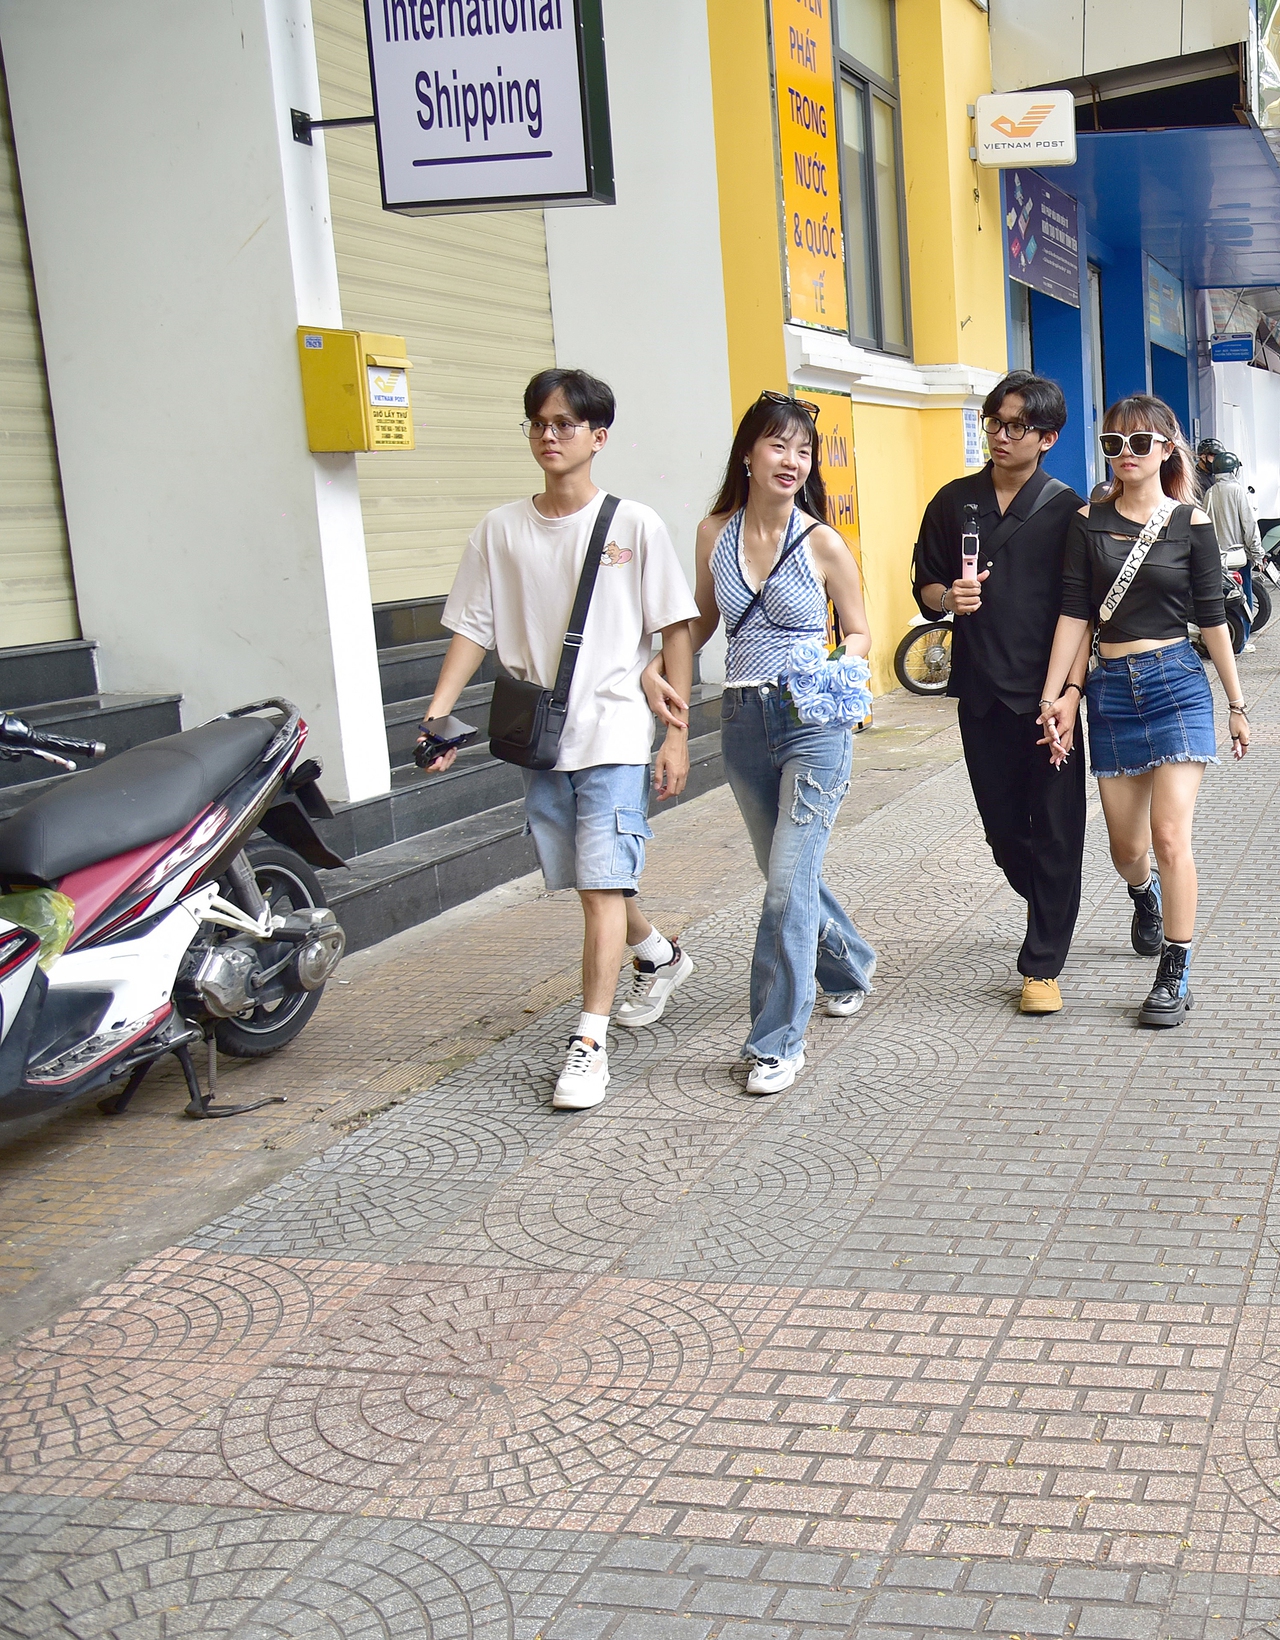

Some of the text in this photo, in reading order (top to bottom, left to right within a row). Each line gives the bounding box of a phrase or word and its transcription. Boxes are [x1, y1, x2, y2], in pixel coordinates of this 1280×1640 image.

[383, 0, 562, 42] International
[789, 25, 816, 73] PHÁT
[415, 65, 542, 142] Shipping
[788, 87, 827, 139] TRONG
[983, 140, 1065, 150] VIETNAM POST
[794, 151, 828, 198] NƯỚC
[794, 212, 837, 260] & QUỐC
[811, 270, 826, 315] TẾ
[826, 424, 848, 468] VẤN
[838, 485, 855, 526] PHÍ
